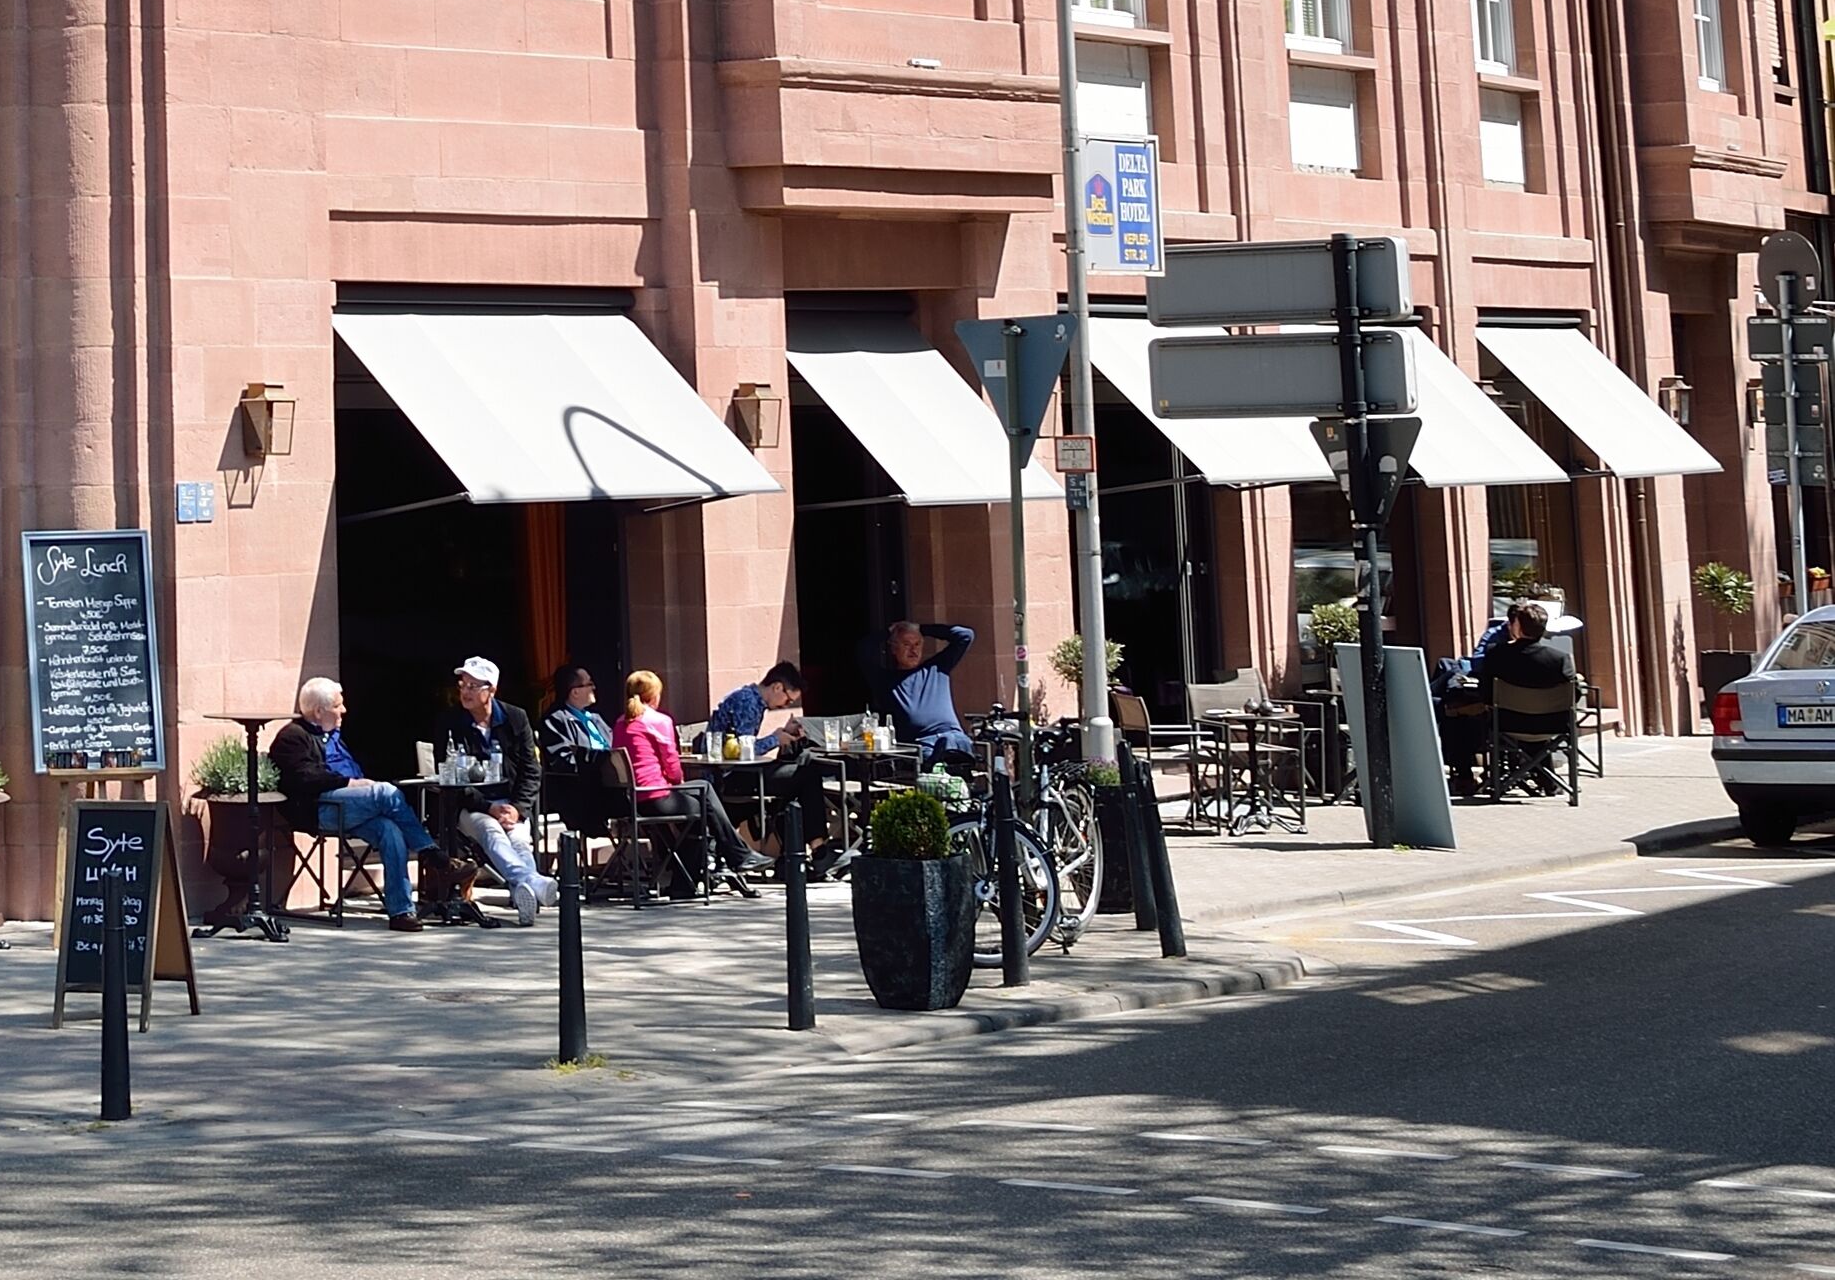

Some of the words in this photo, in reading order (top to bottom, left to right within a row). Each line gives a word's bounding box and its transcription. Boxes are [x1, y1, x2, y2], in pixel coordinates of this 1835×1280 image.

[1118, 153, 1149, 174] DELTA
[1121, 178, 1147, 198] PARK
[1120, 202, 1150, 222] HOTEL
[37, 546, 77, 585] Syte
[80, 547, 128, 577] Lunch
[1788, 708, 1805, 722] MA
[1815, 708, 1833, 722] AM
[84, 827, 144, 862] Syte
